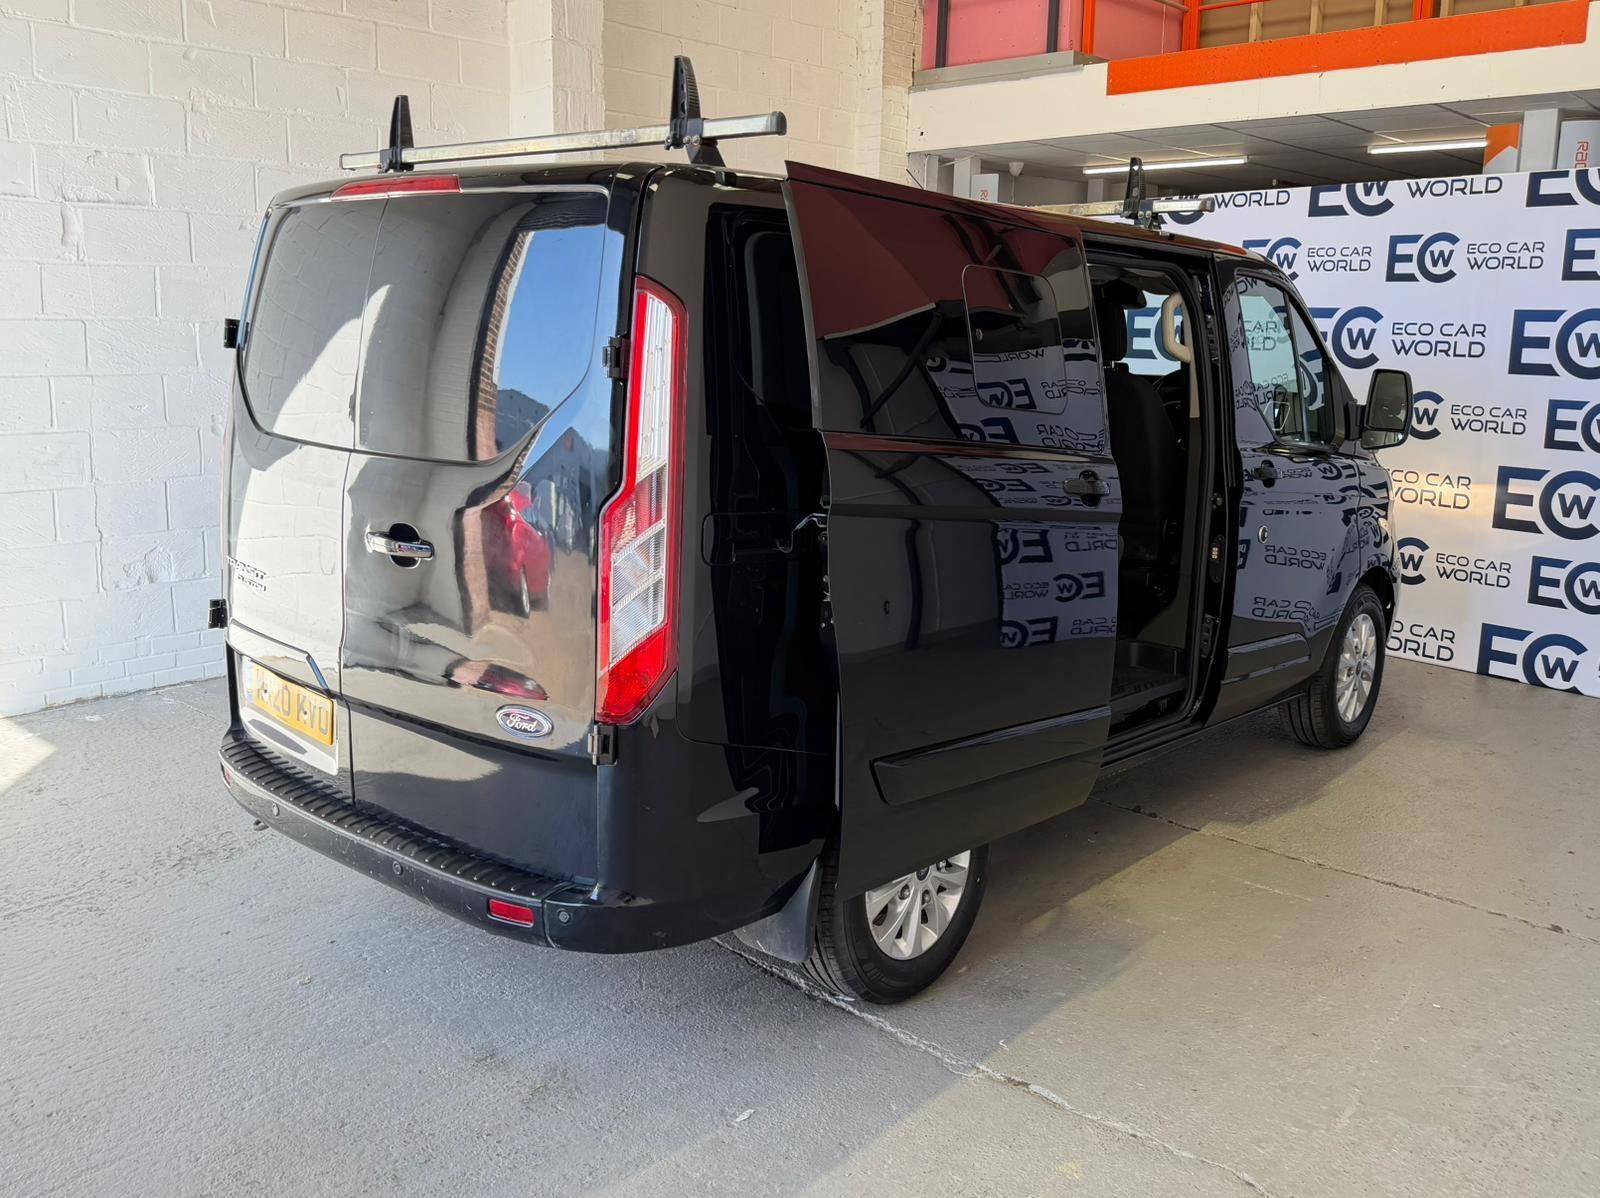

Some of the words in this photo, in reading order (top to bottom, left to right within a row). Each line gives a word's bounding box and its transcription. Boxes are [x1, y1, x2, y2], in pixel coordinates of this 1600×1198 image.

[1407, 177, 1503, 199] WORLD
[1215, 190, 1291, 209] WORLD
[1307, 247, 1337, 258] ECO
[1340, 246, 1372, 257] CAR
[1467, 242, 1502, 254] ECO
[1506, 241, 1545, 254] CAR
[1307, 259, 1371, 272] WORLD
[1385, 232, 1461, 284] ECW
[1467, 256, 1544, 270] WORLD
[1392, 322, 1434, 336] ECO
[1440, 323, 1487, 337] CAR
[1392, 339, 1486, 358] WORLD
[1450, 405, 1485, 417] ECO
[1489, 406, 1527, 420] CAR
[1450, 418, 1526, 435] WORLD
[1391, 469, 1420, 484] CO
[1425, 473, 1472, 490] CAR
[1492, 465, 1600, 540] ECW
[1436, 553, 1470, 567] ECO
[1474, 558, 1512, 574] CAR
[1436, 565, 1510, 589] WORLD
[1409, 624, 1456, 644] CAR
[1386, 635, 1454, 662] ORLD
[507, 713, 538, 732] Ford
